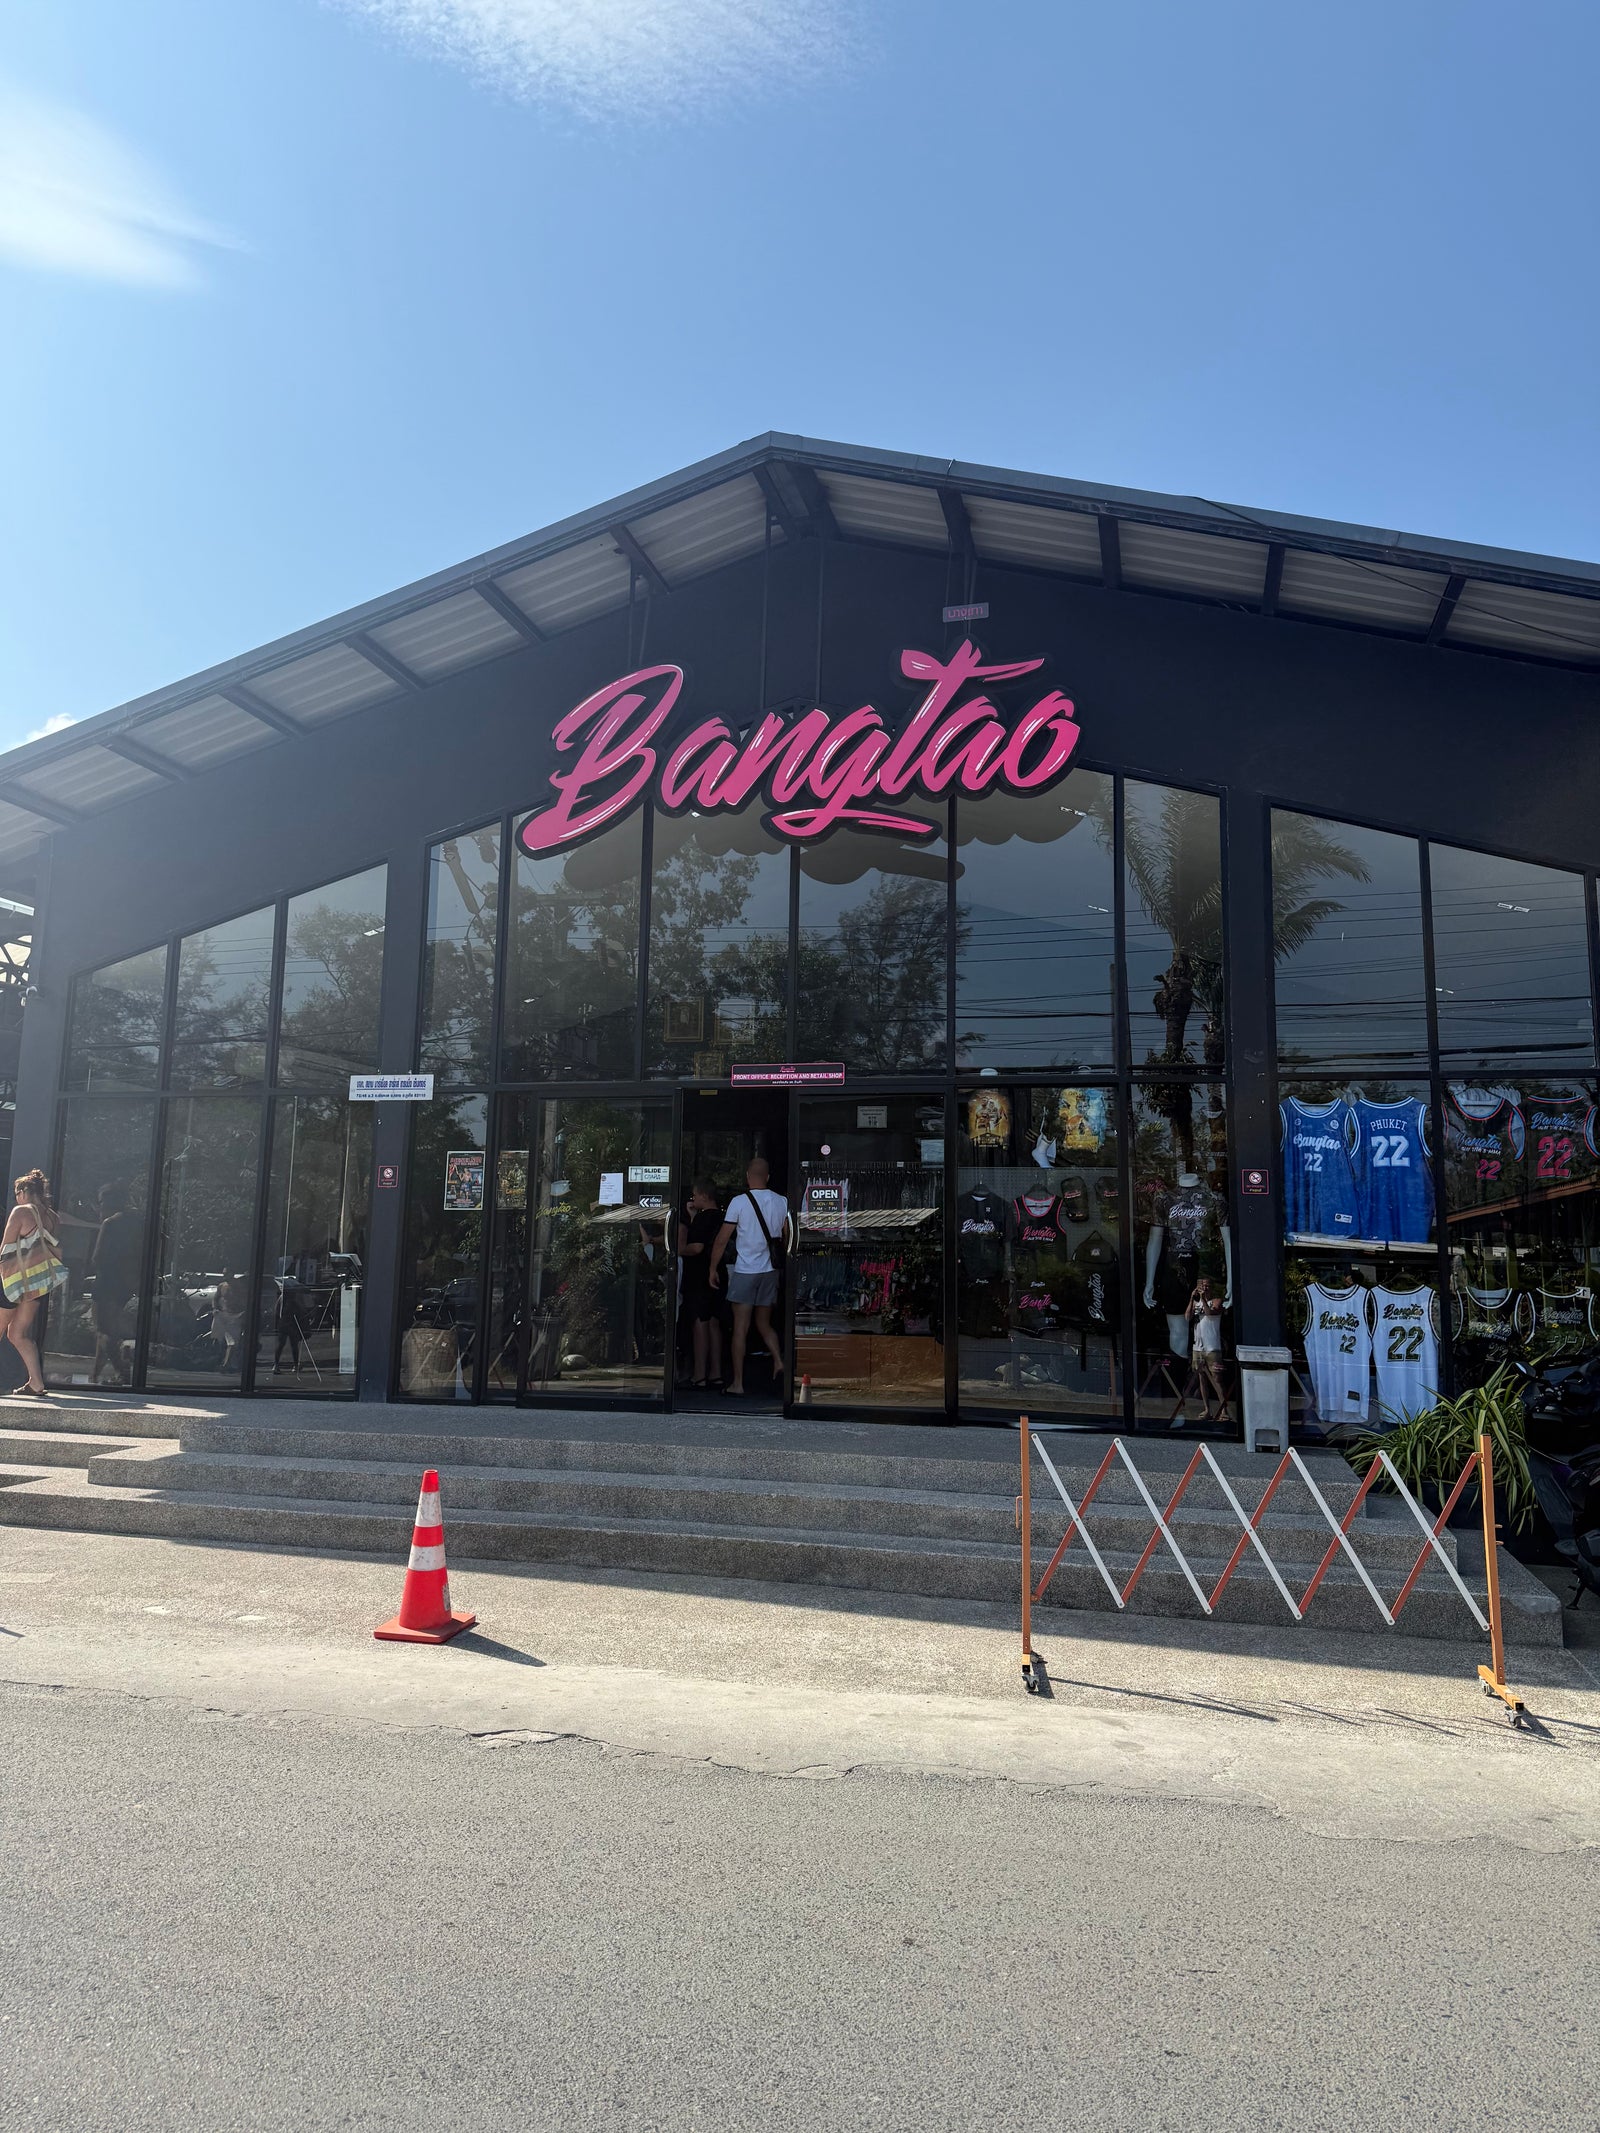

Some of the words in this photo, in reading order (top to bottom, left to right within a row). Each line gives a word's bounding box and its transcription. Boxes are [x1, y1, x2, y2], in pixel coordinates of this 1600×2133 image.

[522, 638, 1082, 851] Bangtao
[1370, 1118, 1408, 1131] PHUKET
[1293, 1133, 1342, 1152] Bangtao
[1371, 1135, 1411, 1168] 22
[1304, 1152, 1324, 1172] 22
[1536, 1136, 1577, 1179] 22
[1475, 1158, 1502, 1181] 22
[811, 1189, 838, 1199] OPEN
[1169, 1205, 1208, 1219] Bangtao
[961, 1218, 995, 1234] Bangtao
[1022, 1225, 1057, 1241] Bangtao
[1088, 1273, 1106, 1322] Bangtao
[1384, 1303, 1425, 1321] Bangtao
[1387, 1325, 1426, 1363] 22
